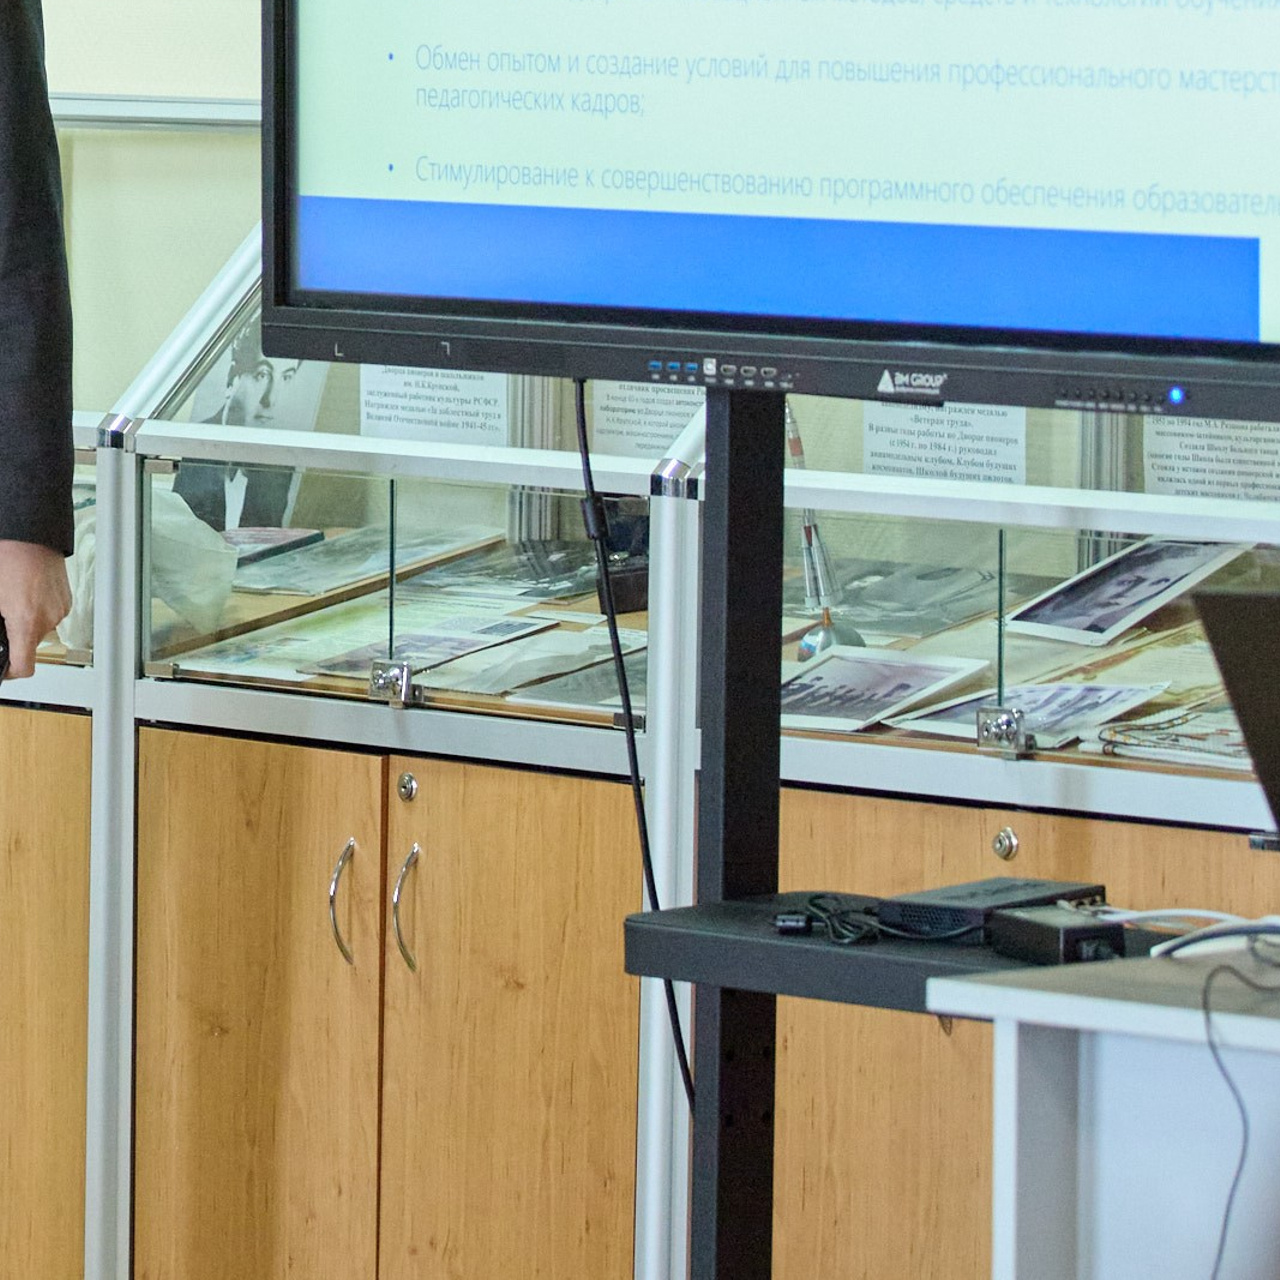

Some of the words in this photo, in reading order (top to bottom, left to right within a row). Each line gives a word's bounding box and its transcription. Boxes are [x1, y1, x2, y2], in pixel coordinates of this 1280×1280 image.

[415, 43, 481, 73] Обмен
[487, 50, 561, 75] опытом
[567, 54, 580, 72] и
[586, 50, 679, 79] создание
[686, 53, 769, 84] условий
[775, 58, 811, 82] для
[818, 58, 941, 84] повышения
[948, 58, 1171, 93] профессионального
[415, 85, 565, 114] педагогических
[415, 155, 580, 190] Стимулирование
[585, 167, 595, 188] к
[601, 167, 813, 199] совершенствованию
[819, 174, 975, 207] программного
[981, 175, 1125, 210] обеспечения
[1132, 182, 1280, 218] образовател
